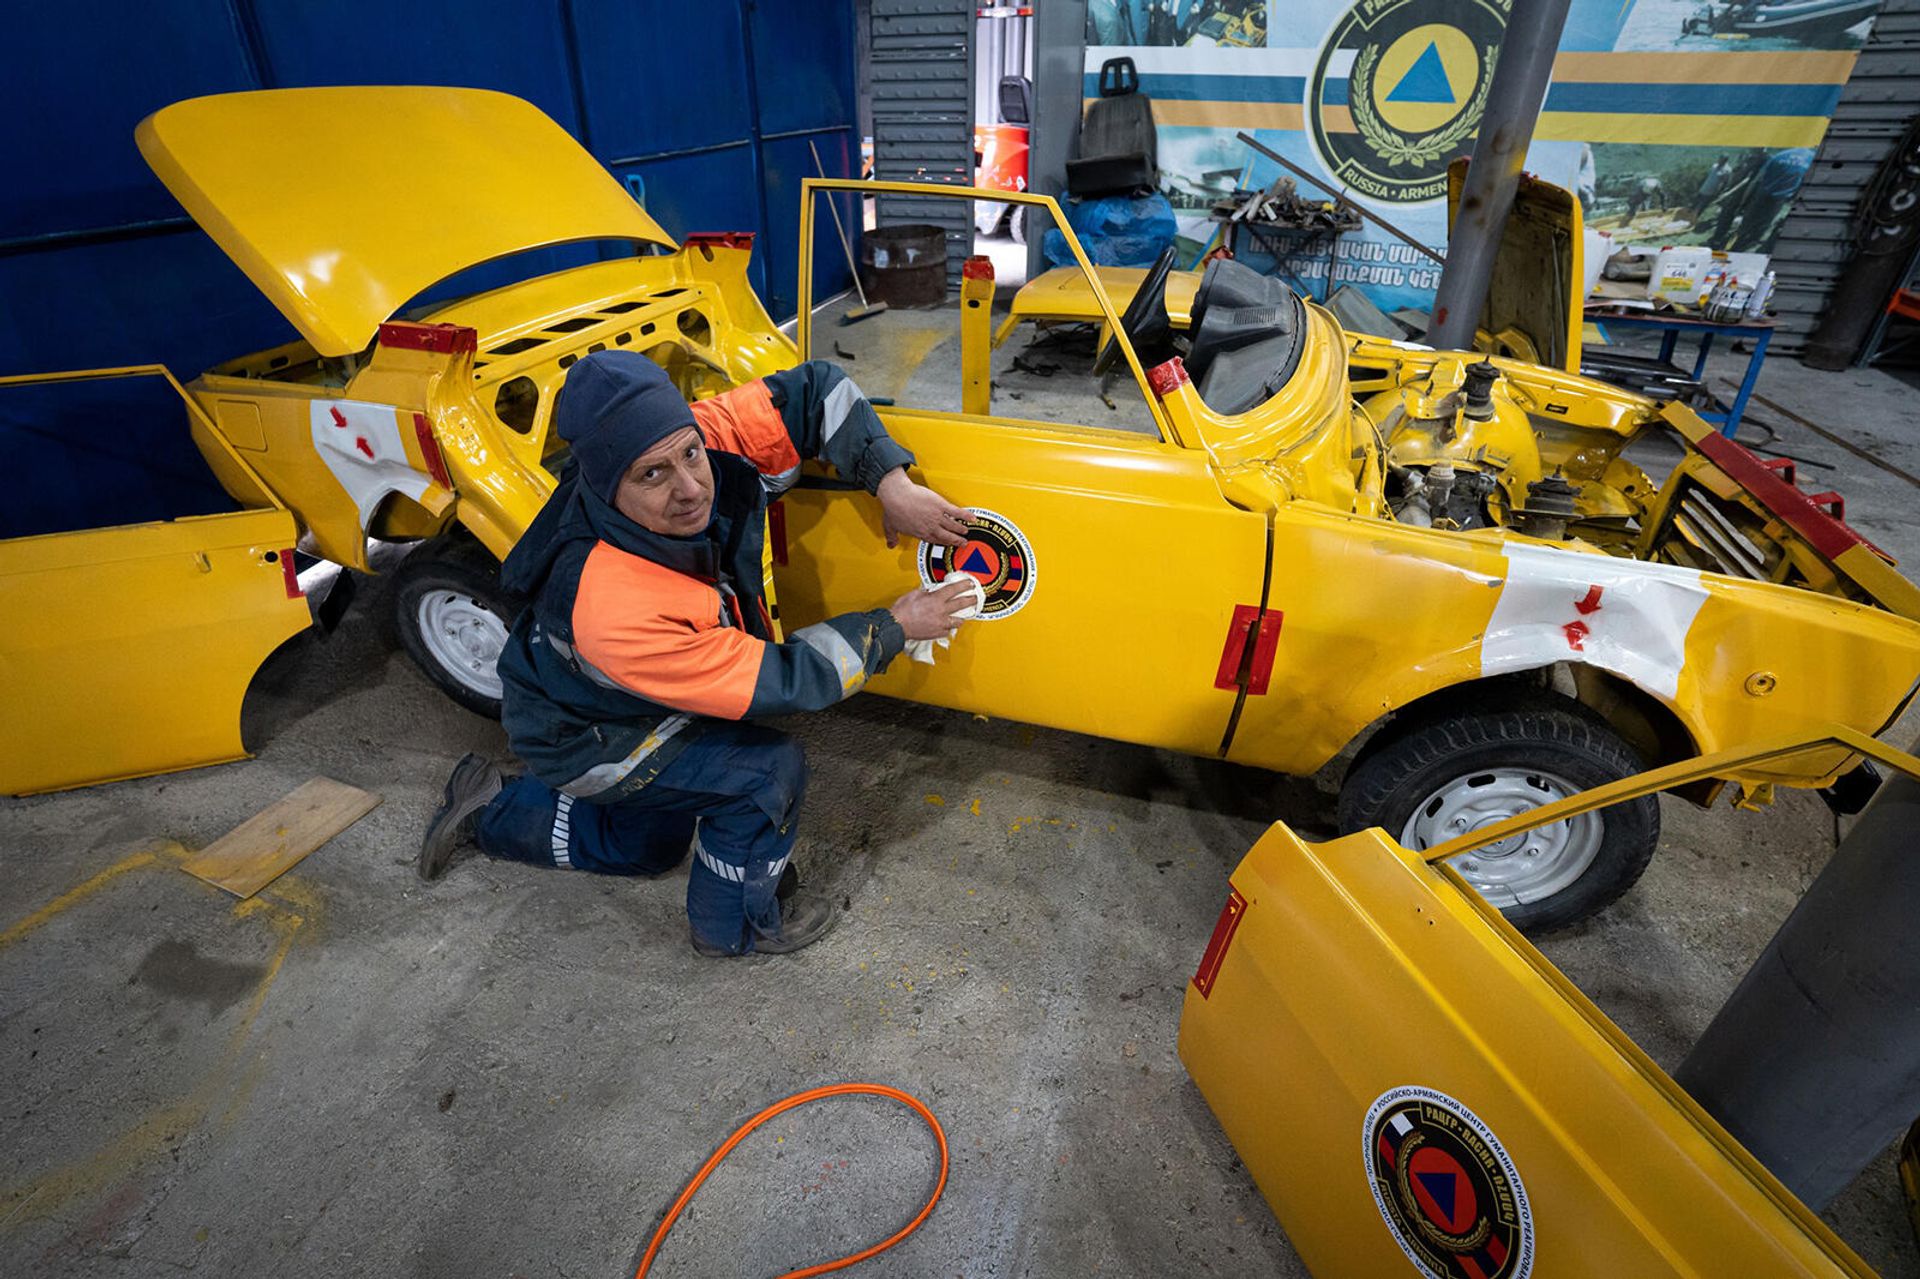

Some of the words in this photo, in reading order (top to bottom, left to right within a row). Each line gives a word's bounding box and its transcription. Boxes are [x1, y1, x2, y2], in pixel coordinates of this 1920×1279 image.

[1344, 169, 1388, 198] RUSSIA
[1398, 181, 1447, 200] ARMEN
[1426, 1105, 1458, 1130] РАЦГР
[1377, 1088, 1460, 1112] РОССИЙСКО-АРМЯНСКИЙ
[1460, 1107, 1487, 1134] ЦЕНТР
[1485, 1131, 1530, 1220] ГУМАНИТАРНОГО
[1517, 1222, 1533, 1279] РЕАГИРОВАН
[1379, 1183, 1402, 1226] RUSSIA
[1405, 1233, 1445, 1276] ARMENIA
